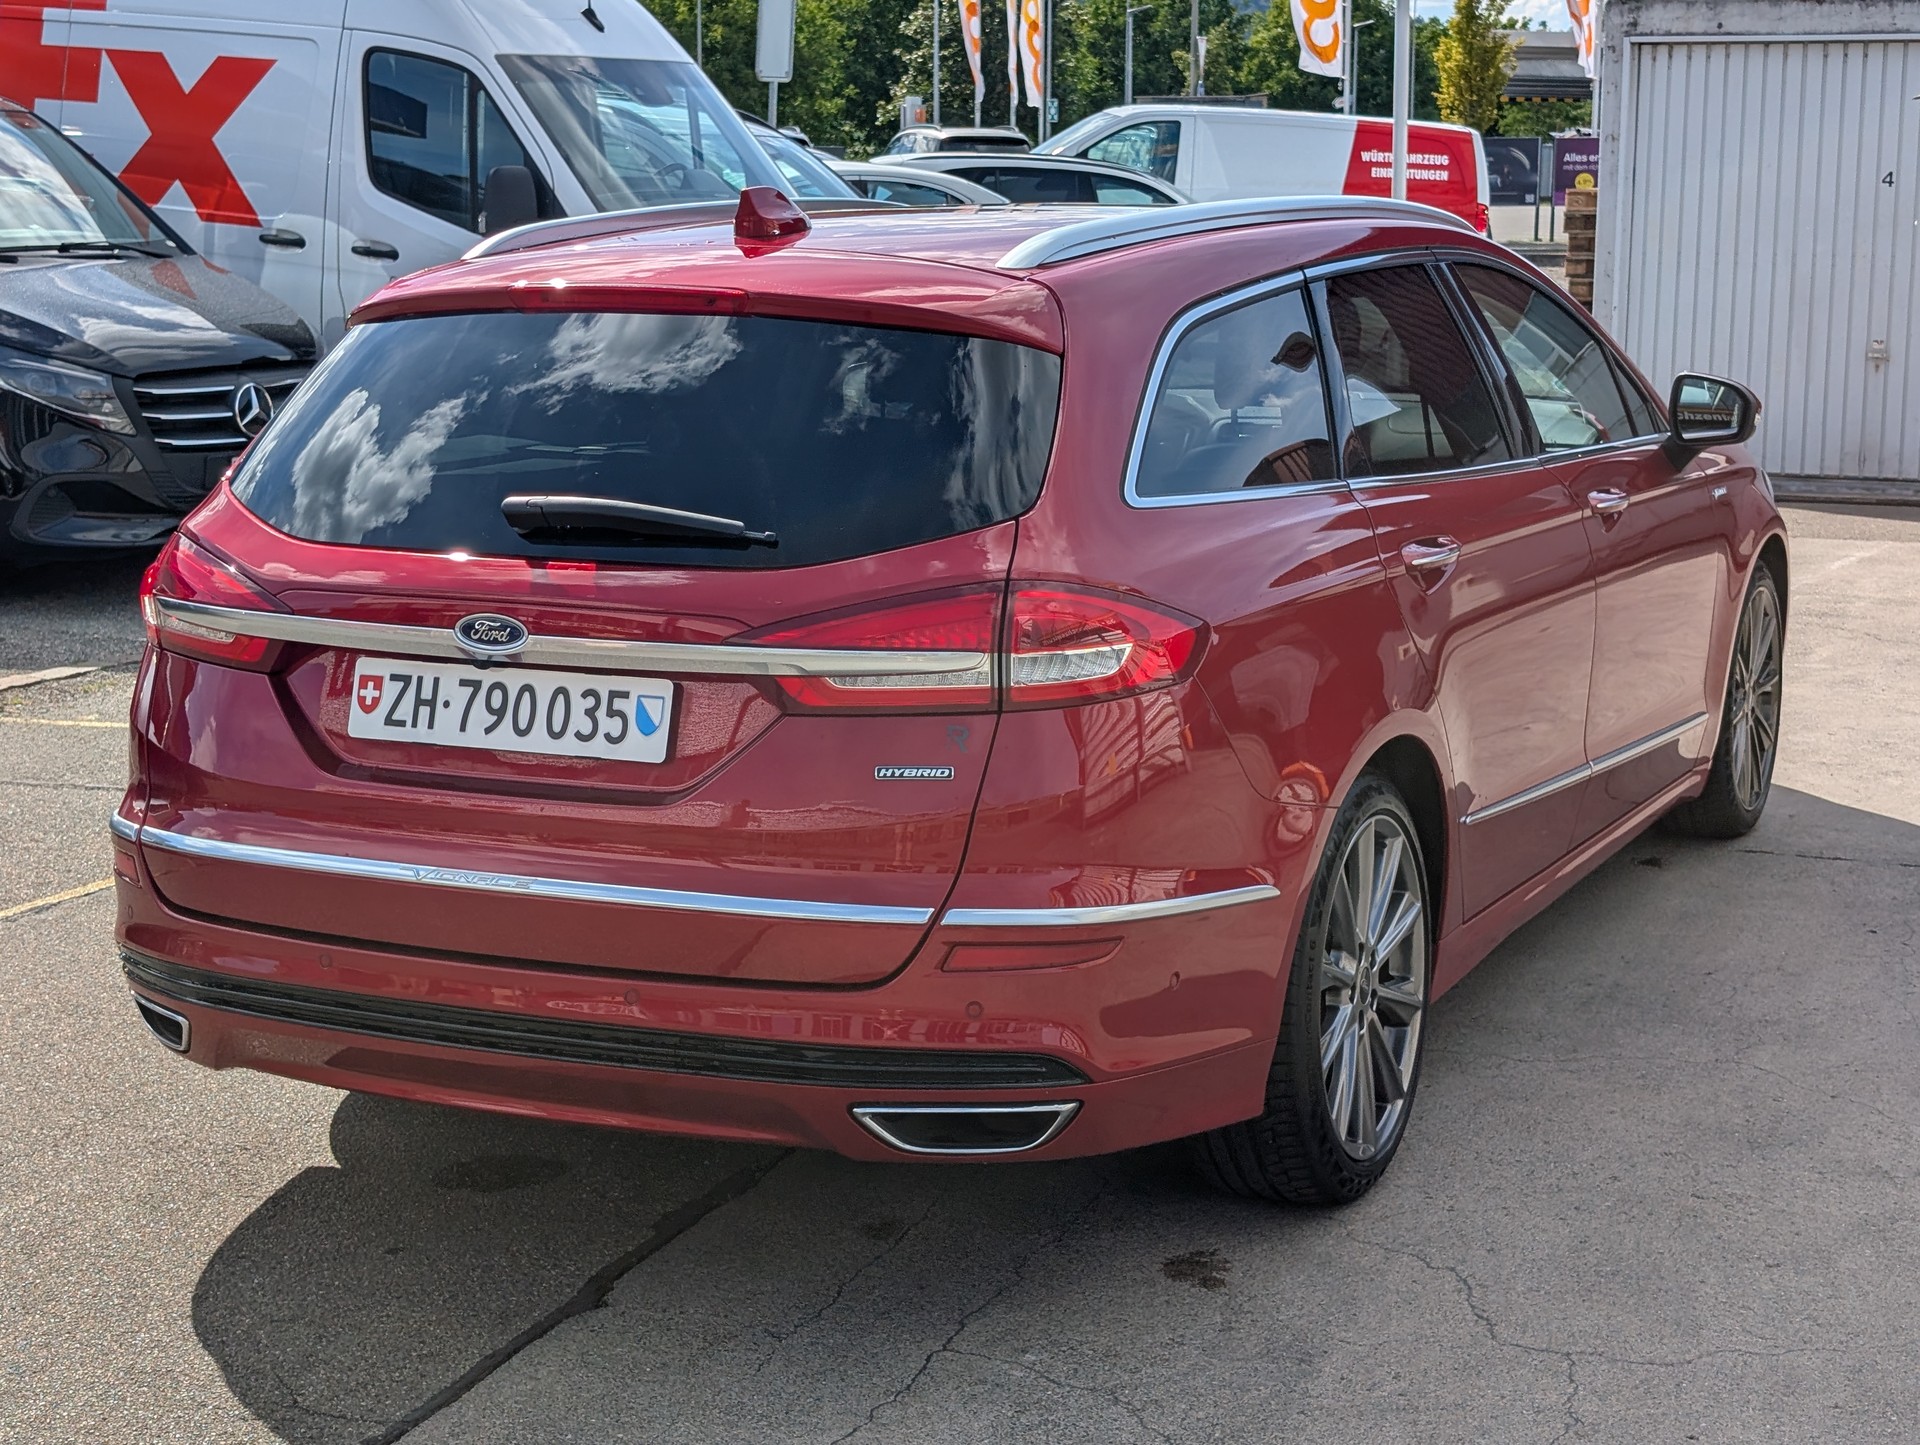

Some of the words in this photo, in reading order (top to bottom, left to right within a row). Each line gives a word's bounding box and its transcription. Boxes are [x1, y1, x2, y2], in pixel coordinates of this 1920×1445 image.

[1405, 153, 1450, 166] AHRZEUG
[1563, 152, 1588, 162] Alles
[1881, 170, 1895, 188] 4
[470, 620, 511, 642] Ford
[879, 768, 950, 777] HYBRID
[400, 866, 538, 889] VIGNALE
